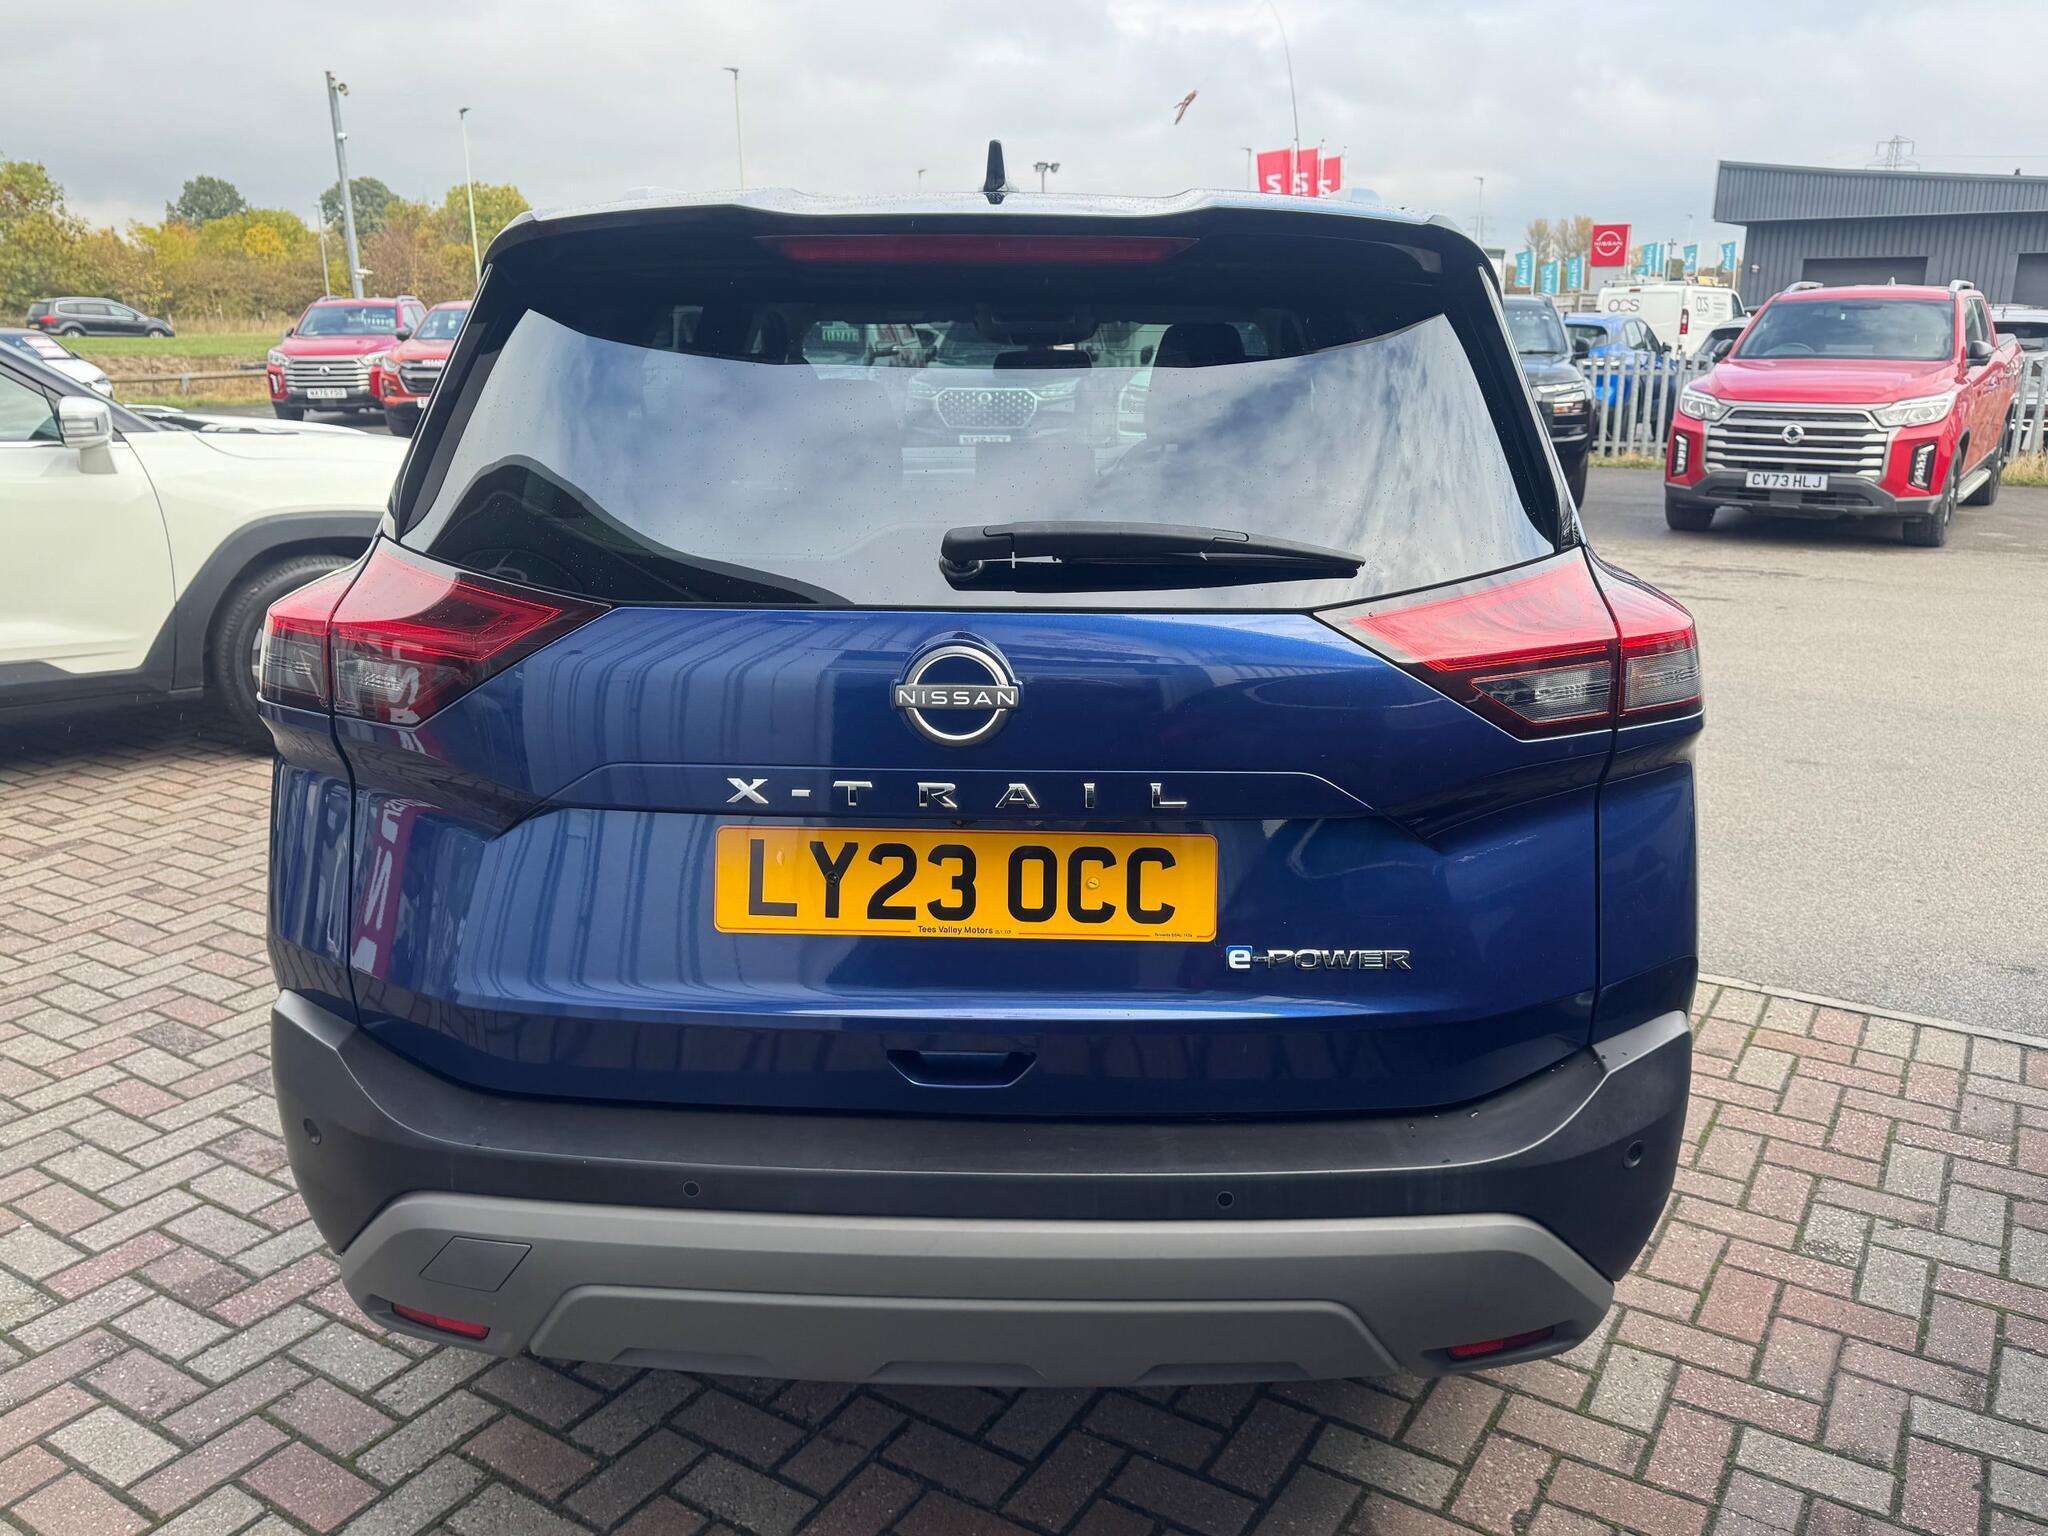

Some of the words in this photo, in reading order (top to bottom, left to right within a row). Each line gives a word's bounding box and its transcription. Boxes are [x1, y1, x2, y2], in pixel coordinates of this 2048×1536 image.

[1608, 299, 1640, 312] OCS
[1752, 473, 1789, 487] CV73
[1792, 474, 1822, 488] HLJ
[899, 690, 1015, 705] NISSAN
[726, 777, 1188, 809] X-TRAIL
[748, 838, 977, 921] LY23
[1007, 845, 1176, 924] OCC
[939, 926, 961, 935] Valley
[1227, 948, 1411, 970] e-POWER
